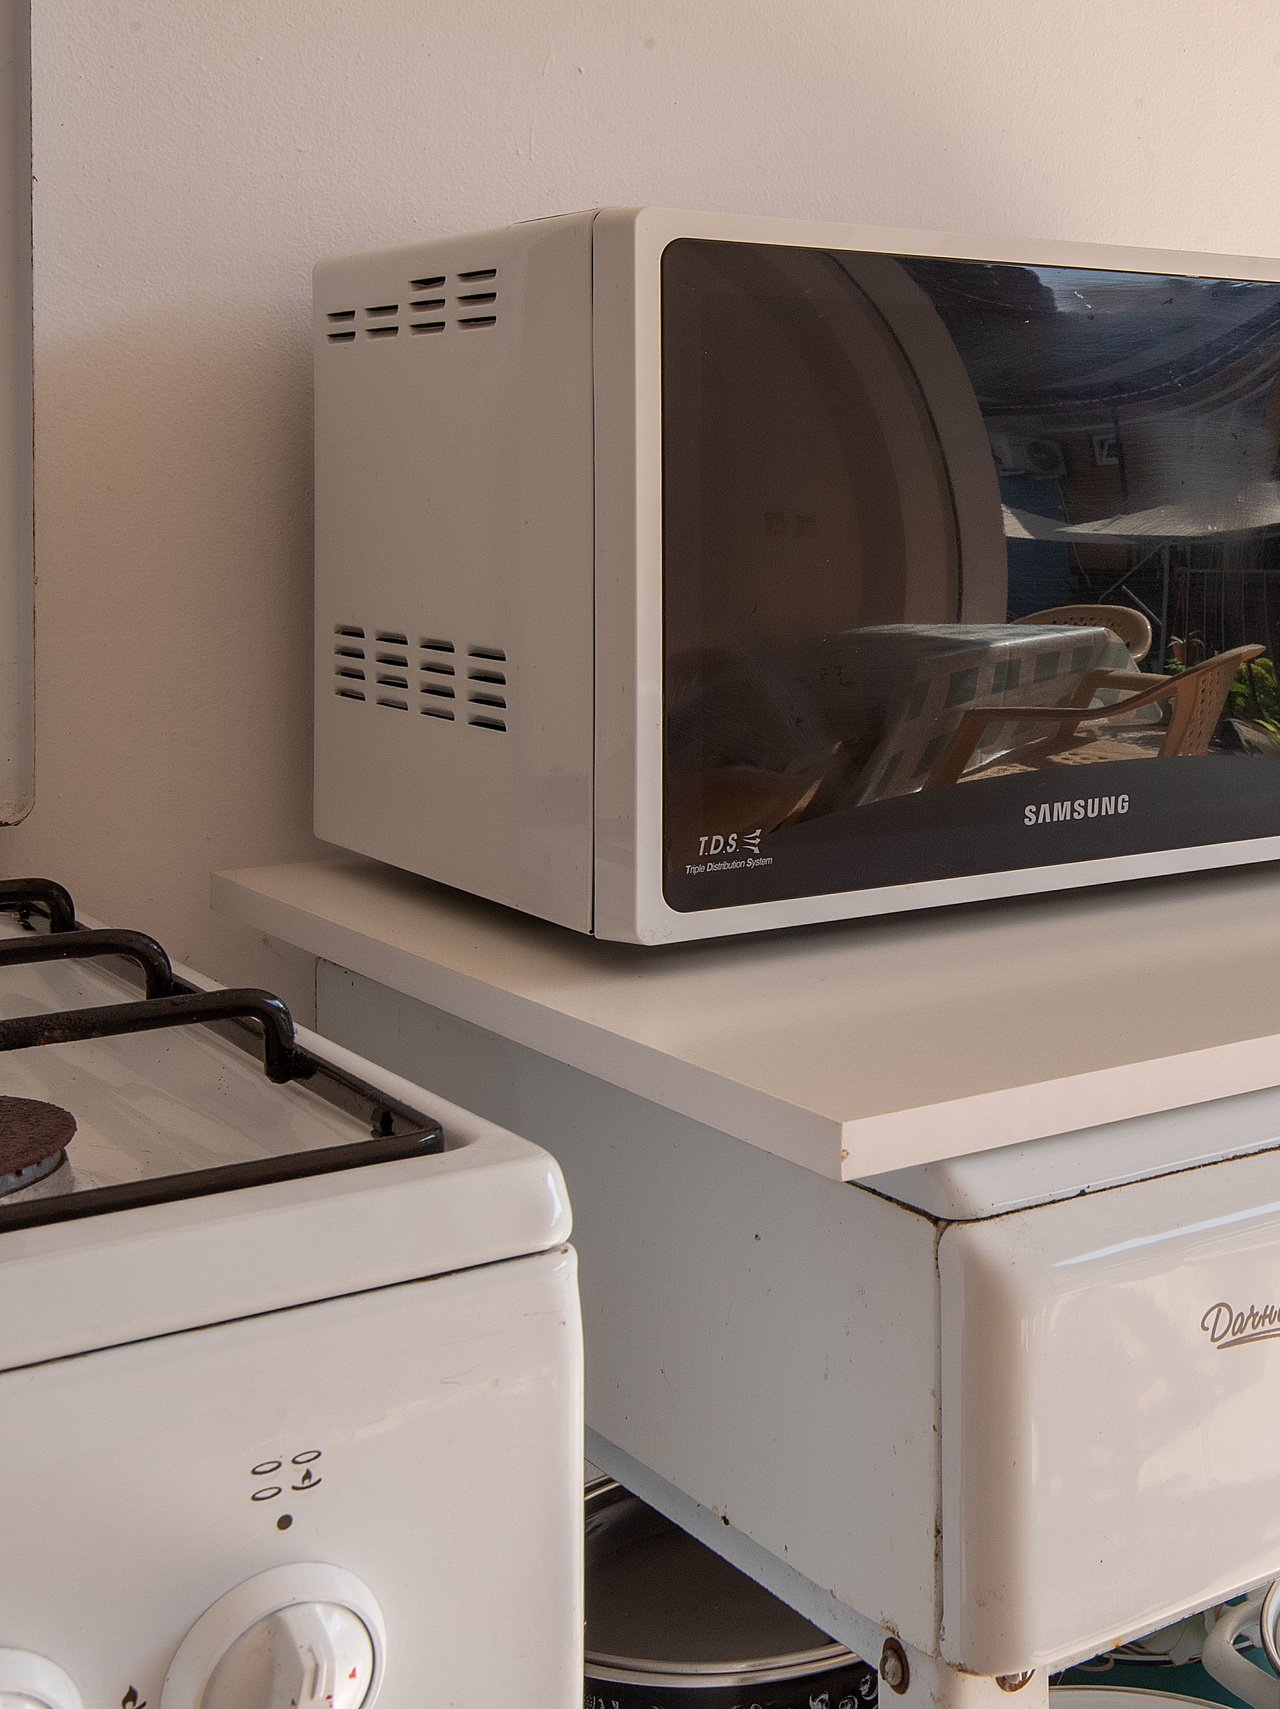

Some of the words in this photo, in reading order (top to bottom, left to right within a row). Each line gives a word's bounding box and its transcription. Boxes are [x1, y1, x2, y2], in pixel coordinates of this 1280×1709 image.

[1024, 794, 1130, 826] SAMSUNG
[699, 833, 740, 856] T.D.S.
[685, 864, 706, 875] Triple
[706, 859, 746, 872] Distribution
[746, 857, 773, 869] System
